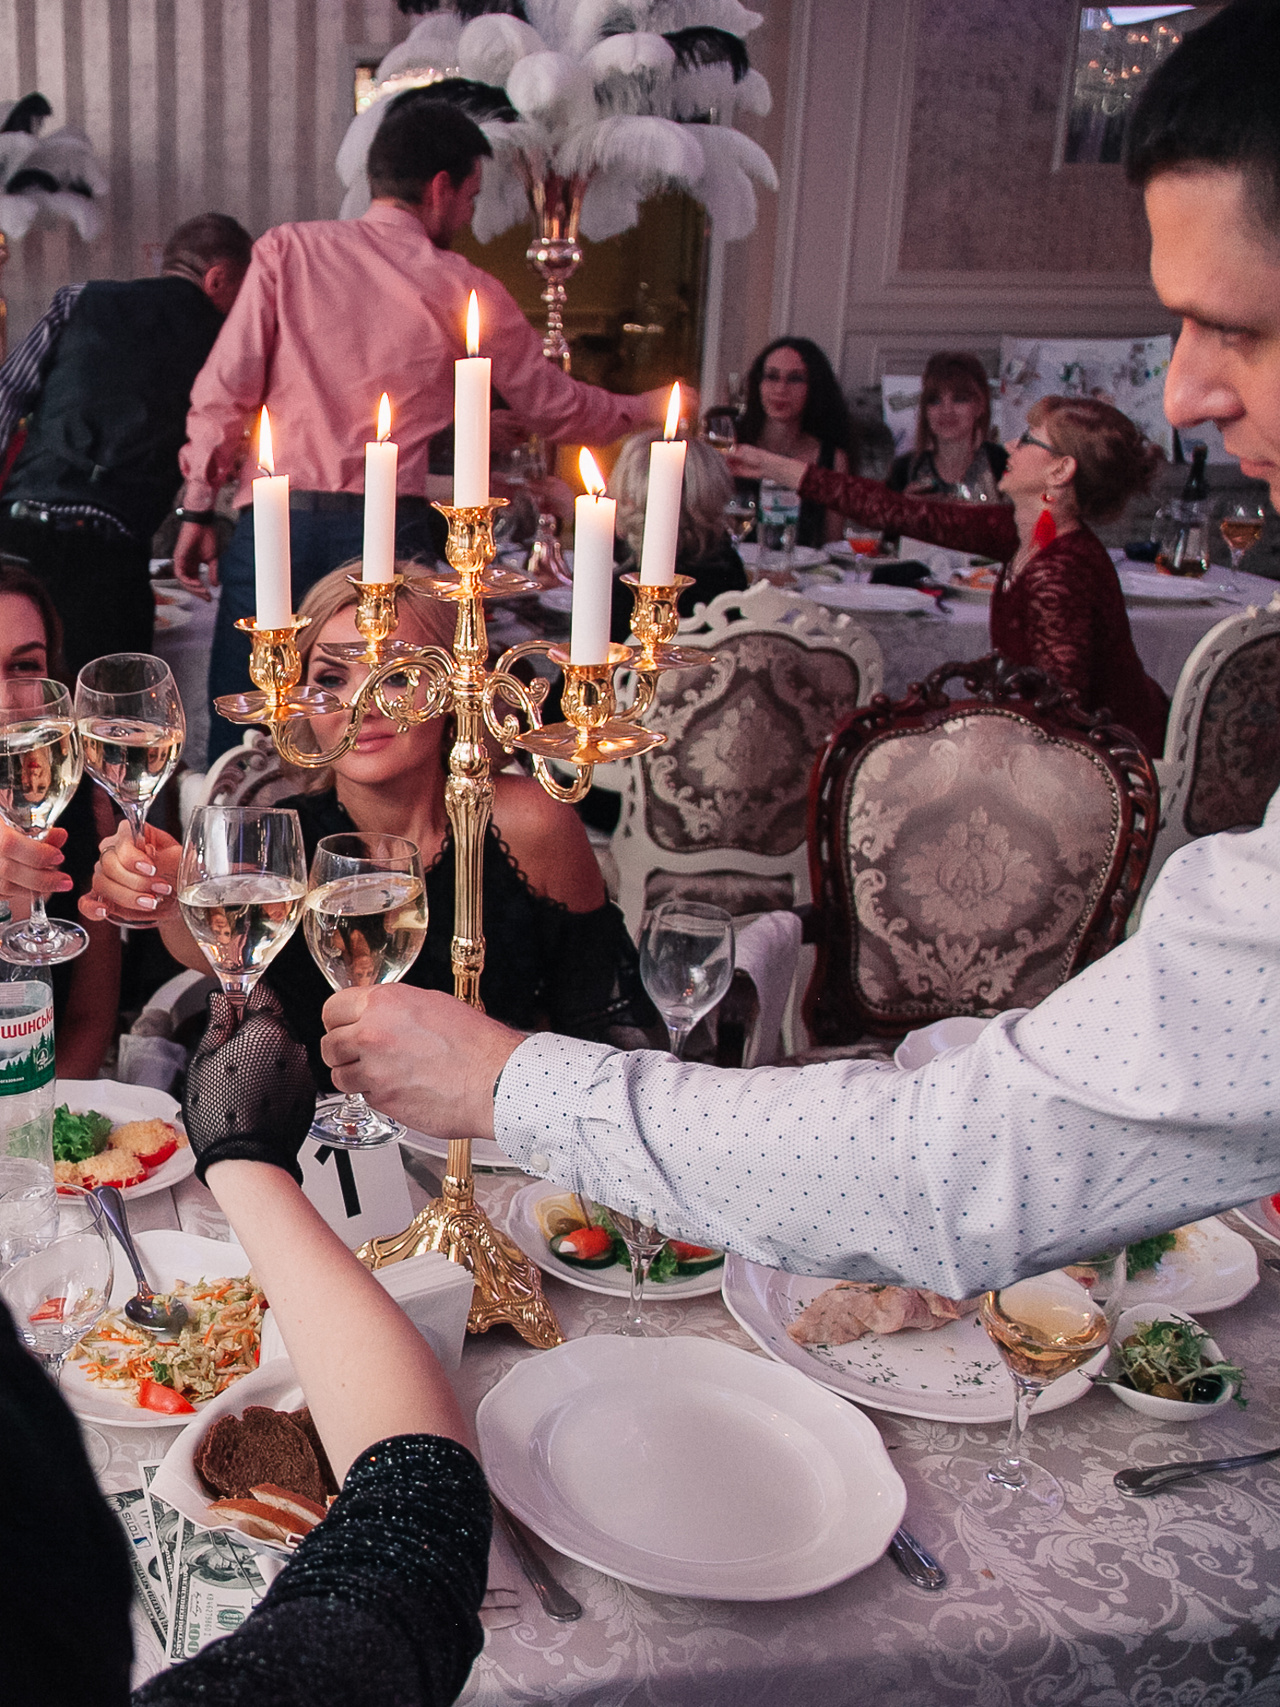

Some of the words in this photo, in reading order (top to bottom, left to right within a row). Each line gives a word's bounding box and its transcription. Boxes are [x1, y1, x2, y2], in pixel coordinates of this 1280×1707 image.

[122, 1511, 139, 1537] TOTIS
[178, 1585, 187, 1619] HUNDRED
[175, 1620, 184, 1654] DOLLARS
[187, 1622, 201, 1653] 100
